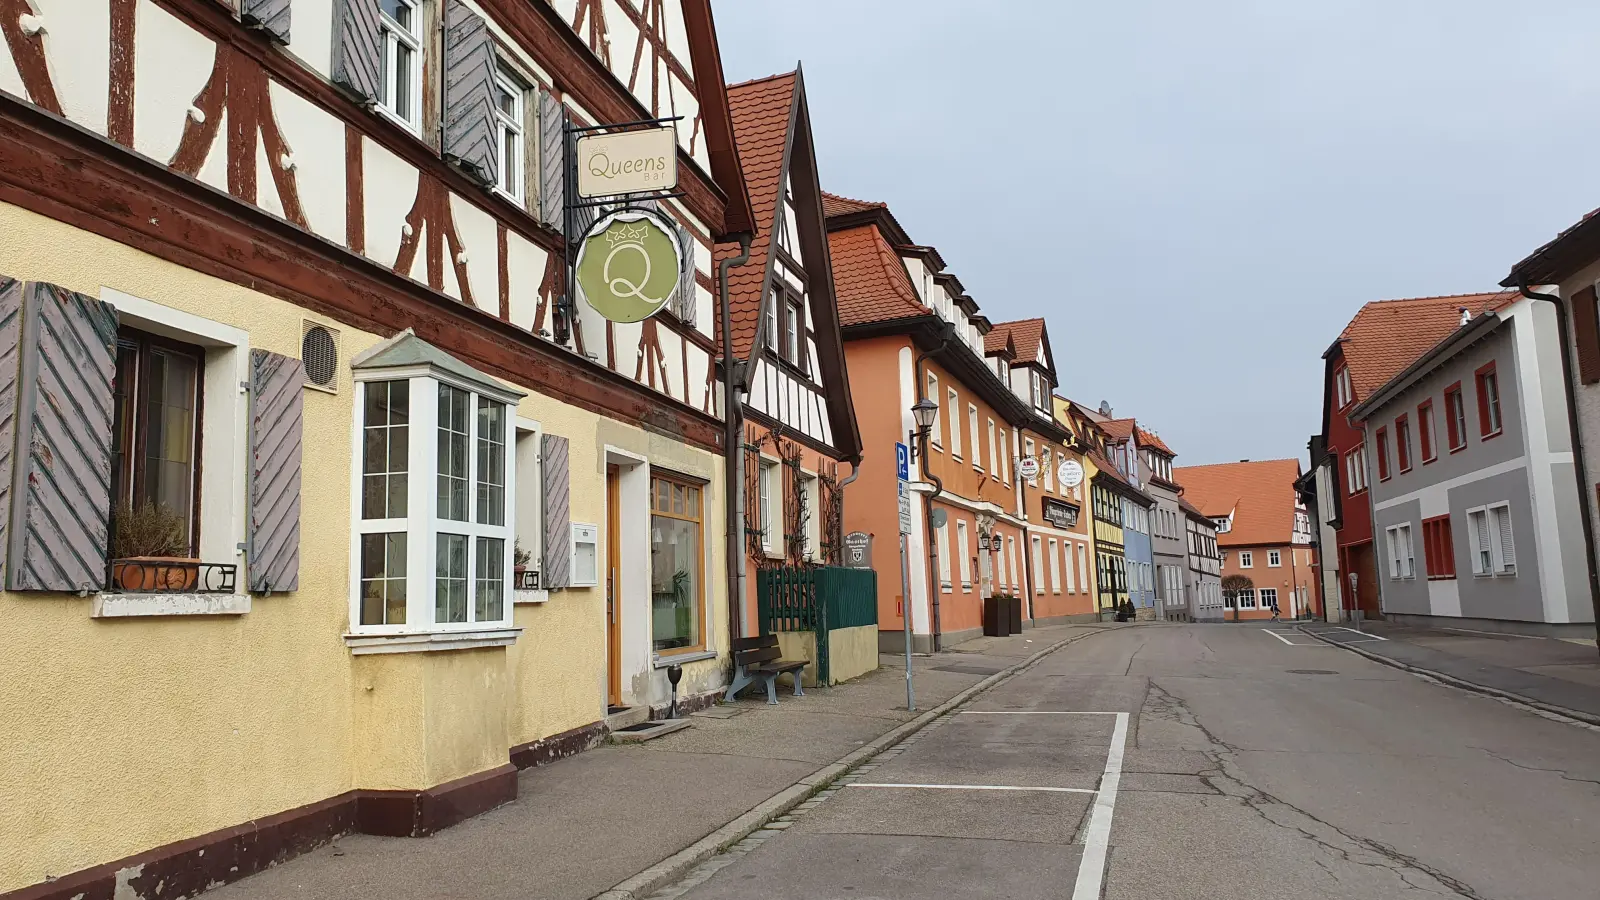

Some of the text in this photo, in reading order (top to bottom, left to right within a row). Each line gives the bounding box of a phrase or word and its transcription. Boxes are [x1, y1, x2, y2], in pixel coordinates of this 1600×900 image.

[588, 153, 665, 179] Queens
[644, 172, 666, 182] Bar
[603, 243, 663, 304] Q
[897, 447, 905, 474] P
